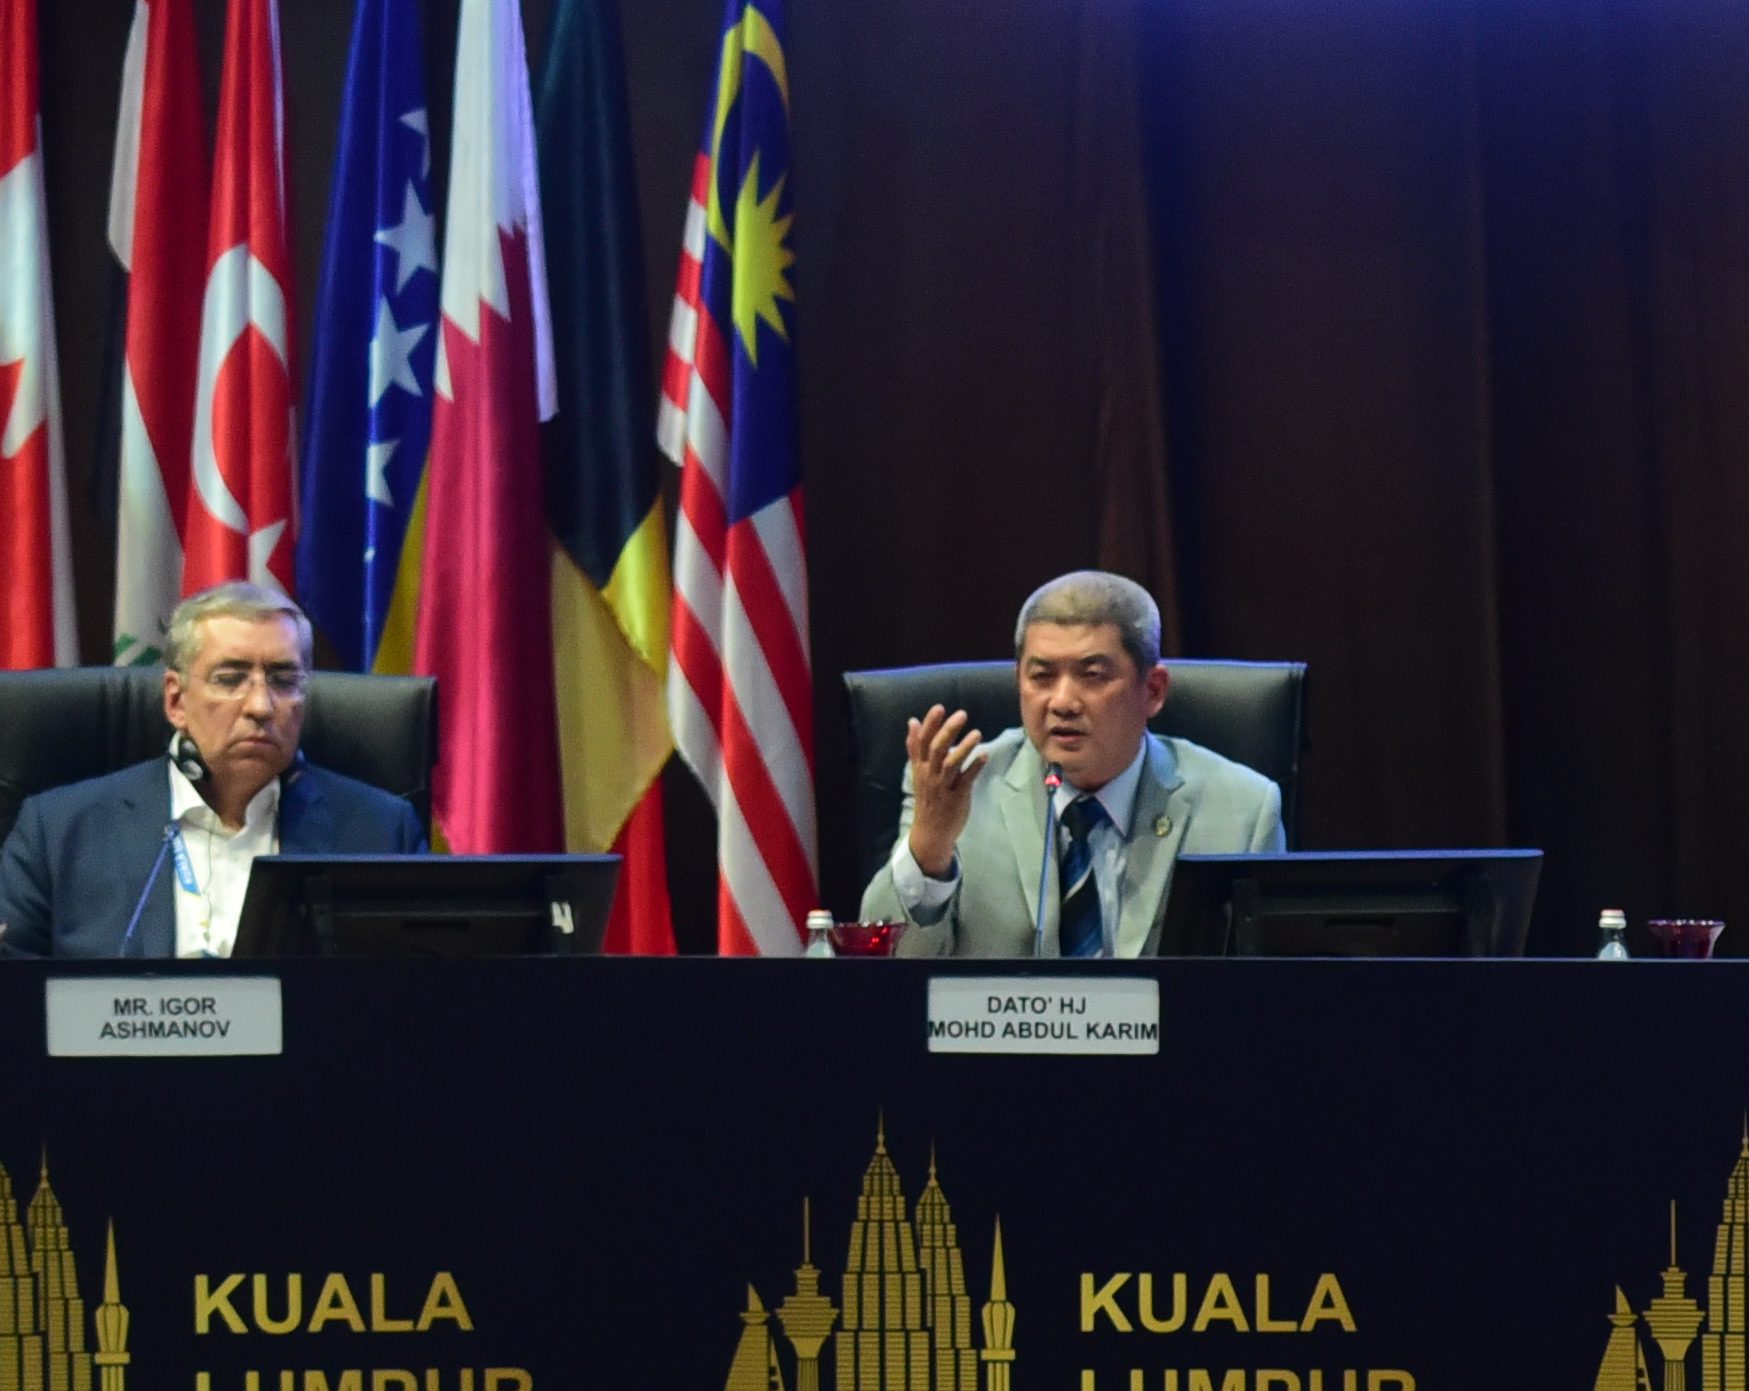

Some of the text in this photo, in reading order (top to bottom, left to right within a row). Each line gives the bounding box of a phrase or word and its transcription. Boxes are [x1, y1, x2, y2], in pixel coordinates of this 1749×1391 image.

[113, 996, 217, 1015] MR. IGOR
[987, 996, 1087, 1016] DATO' HJ
[98, 1019, 232, 1039] ASHMANOV
[929, 1020, 1158, 1040] MOHD ABDUL KARIM
[193, 1273, 472, 1334] KUALA
[1078, 1273, 1355, 1333] KUALA
